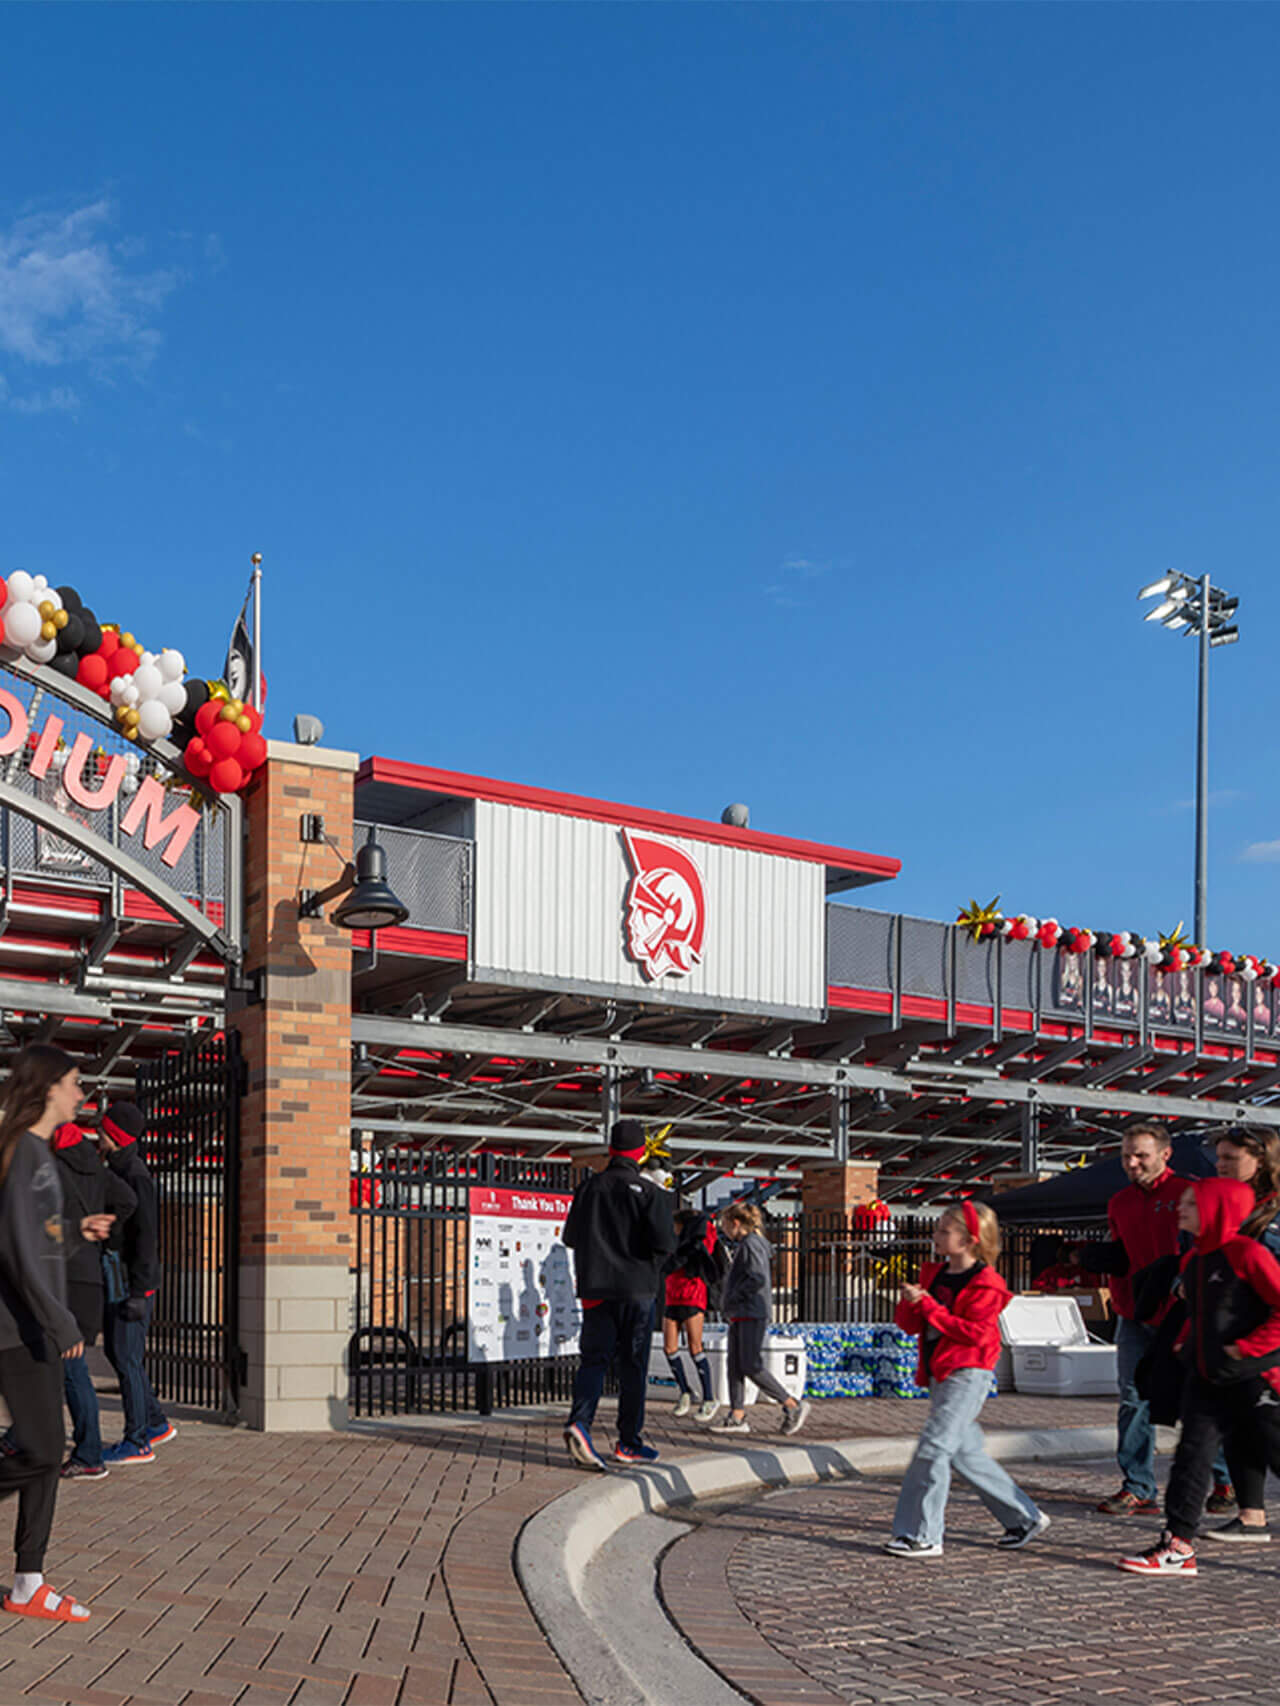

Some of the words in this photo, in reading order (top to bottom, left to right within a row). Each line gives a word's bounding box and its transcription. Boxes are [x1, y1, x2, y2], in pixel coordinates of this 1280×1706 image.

[511, 1195, 538, 1211] Thank
[539, 1198, 554, 1213] You
[554, 1199, 567, 1214] To
